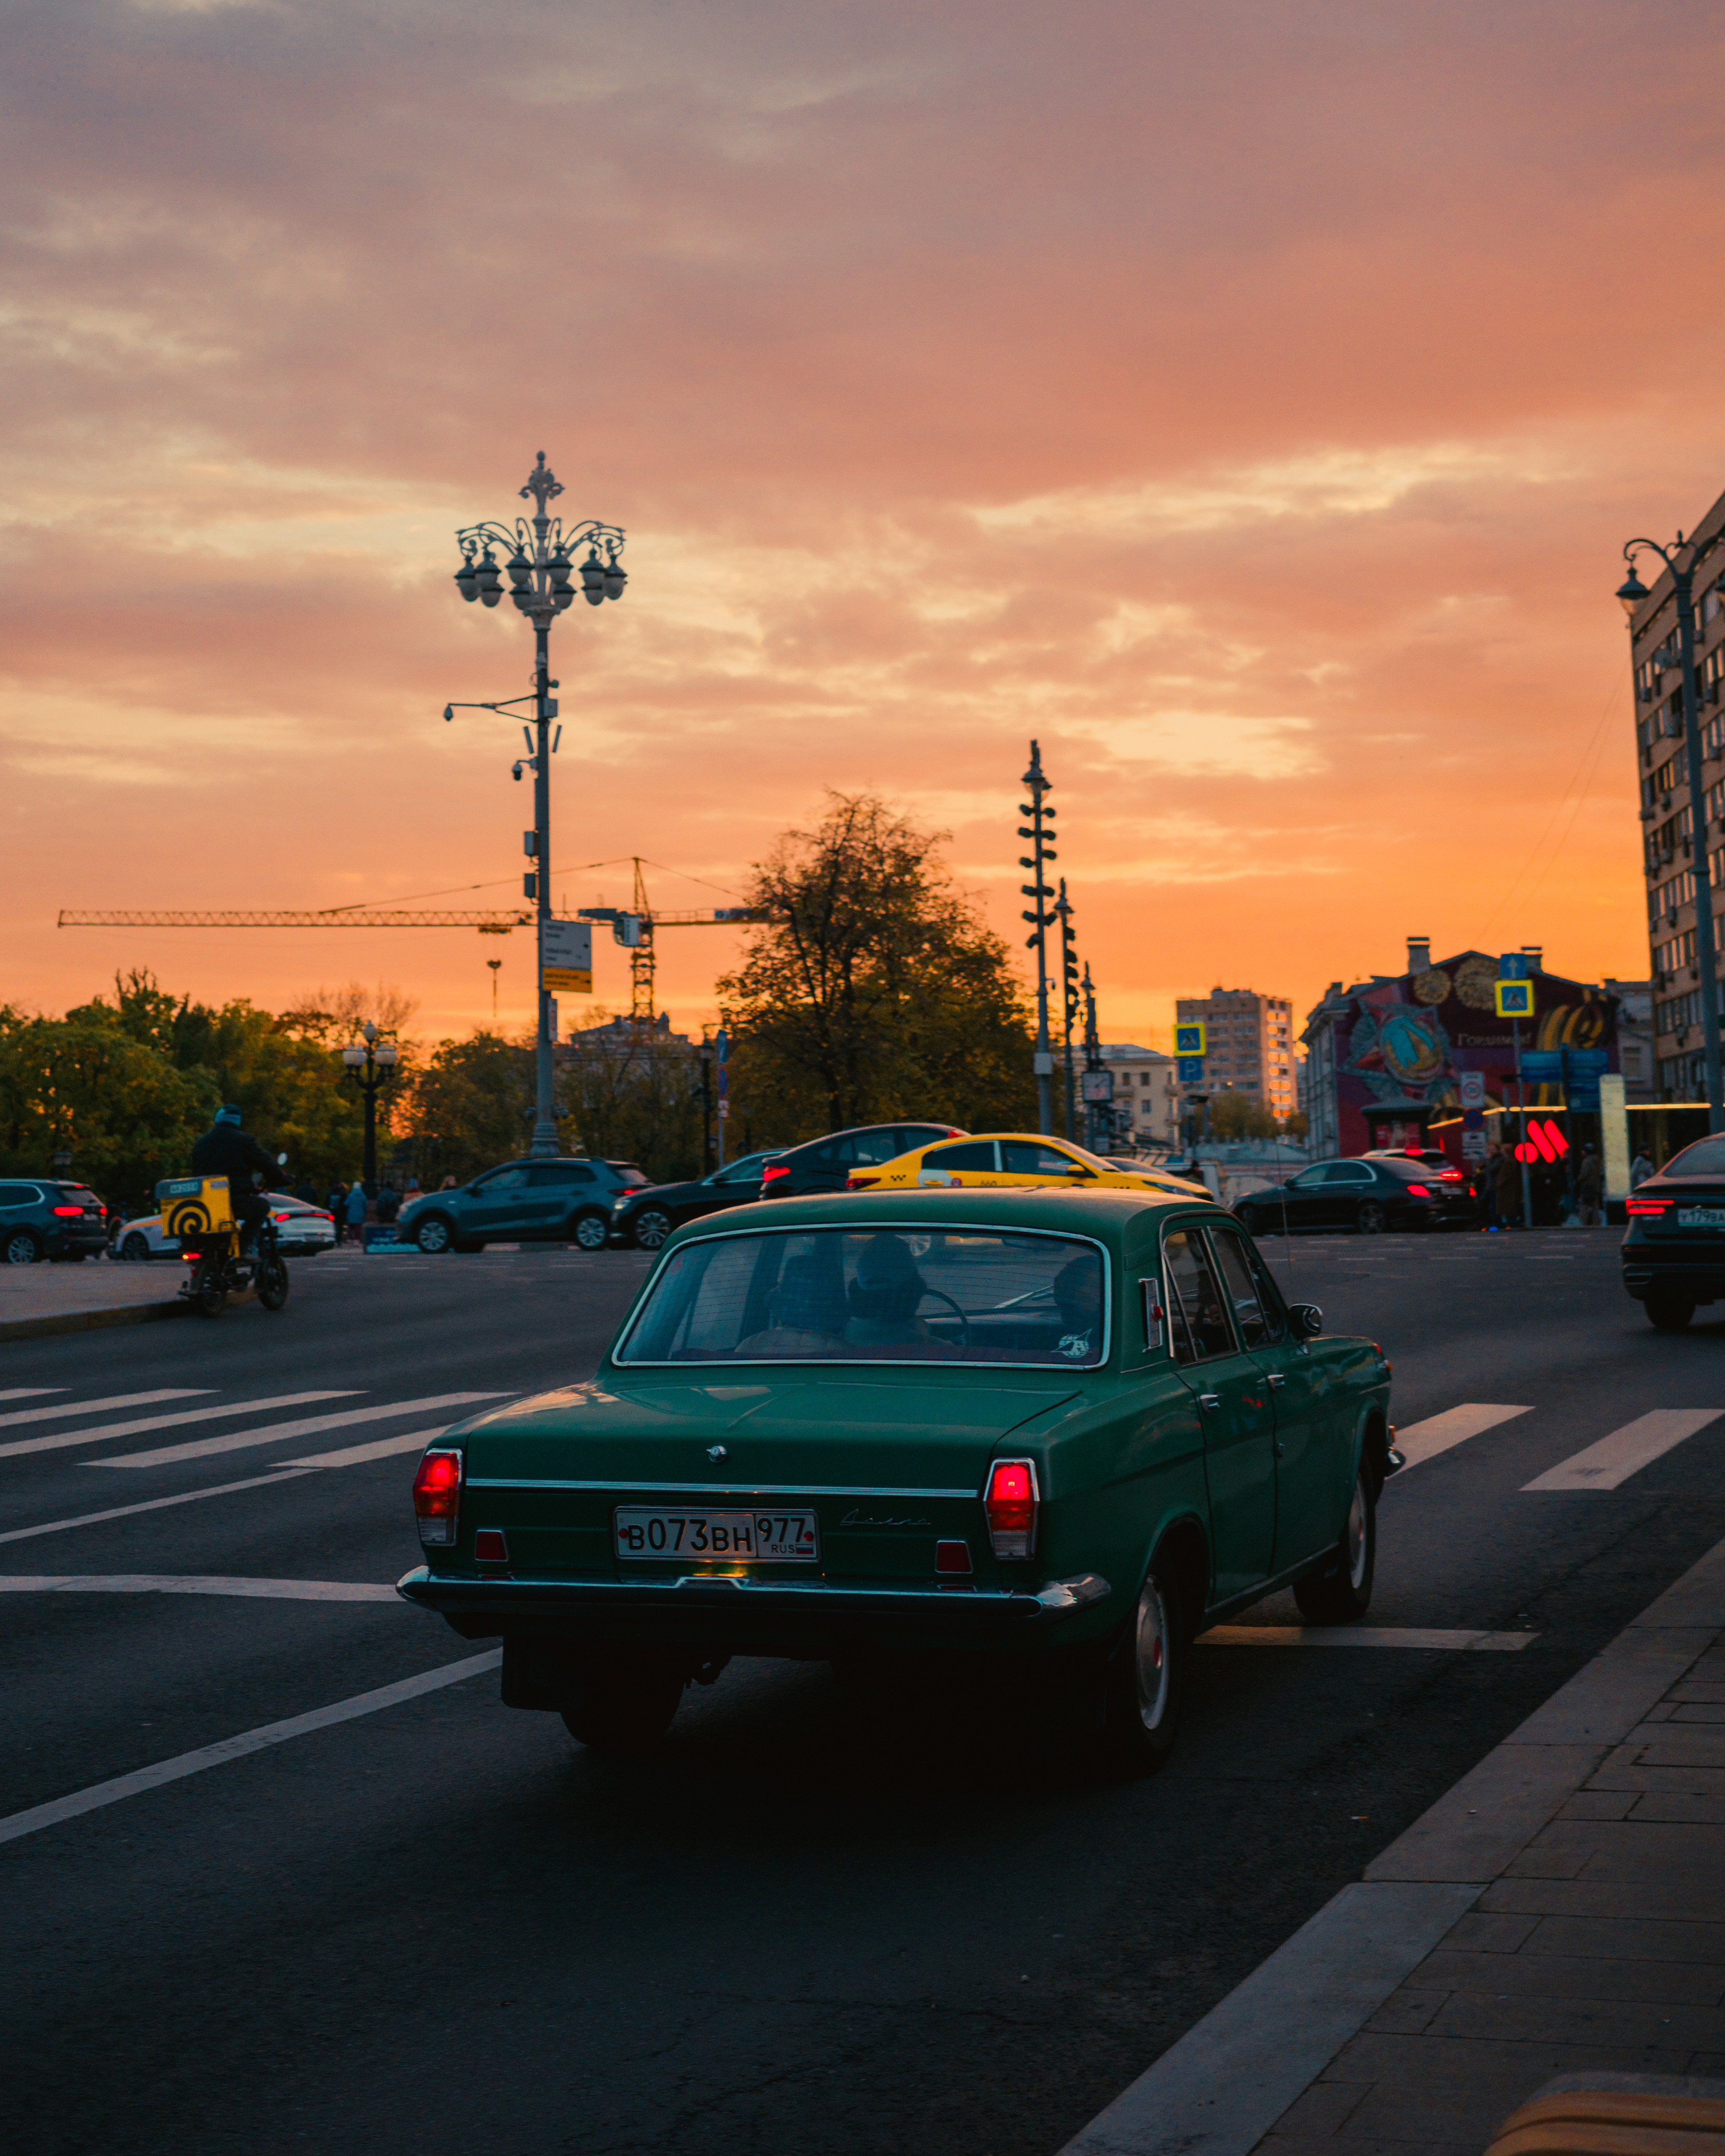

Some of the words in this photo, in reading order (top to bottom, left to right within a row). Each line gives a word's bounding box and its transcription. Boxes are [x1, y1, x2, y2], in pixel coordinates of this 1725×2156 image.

[1186, 1062, 1197, 1079] P
[628, 1518, 752, 1552] В073ВН
[758, 1518, 806, 1543] 977
[771, 1544, 795, 1553] RUS
